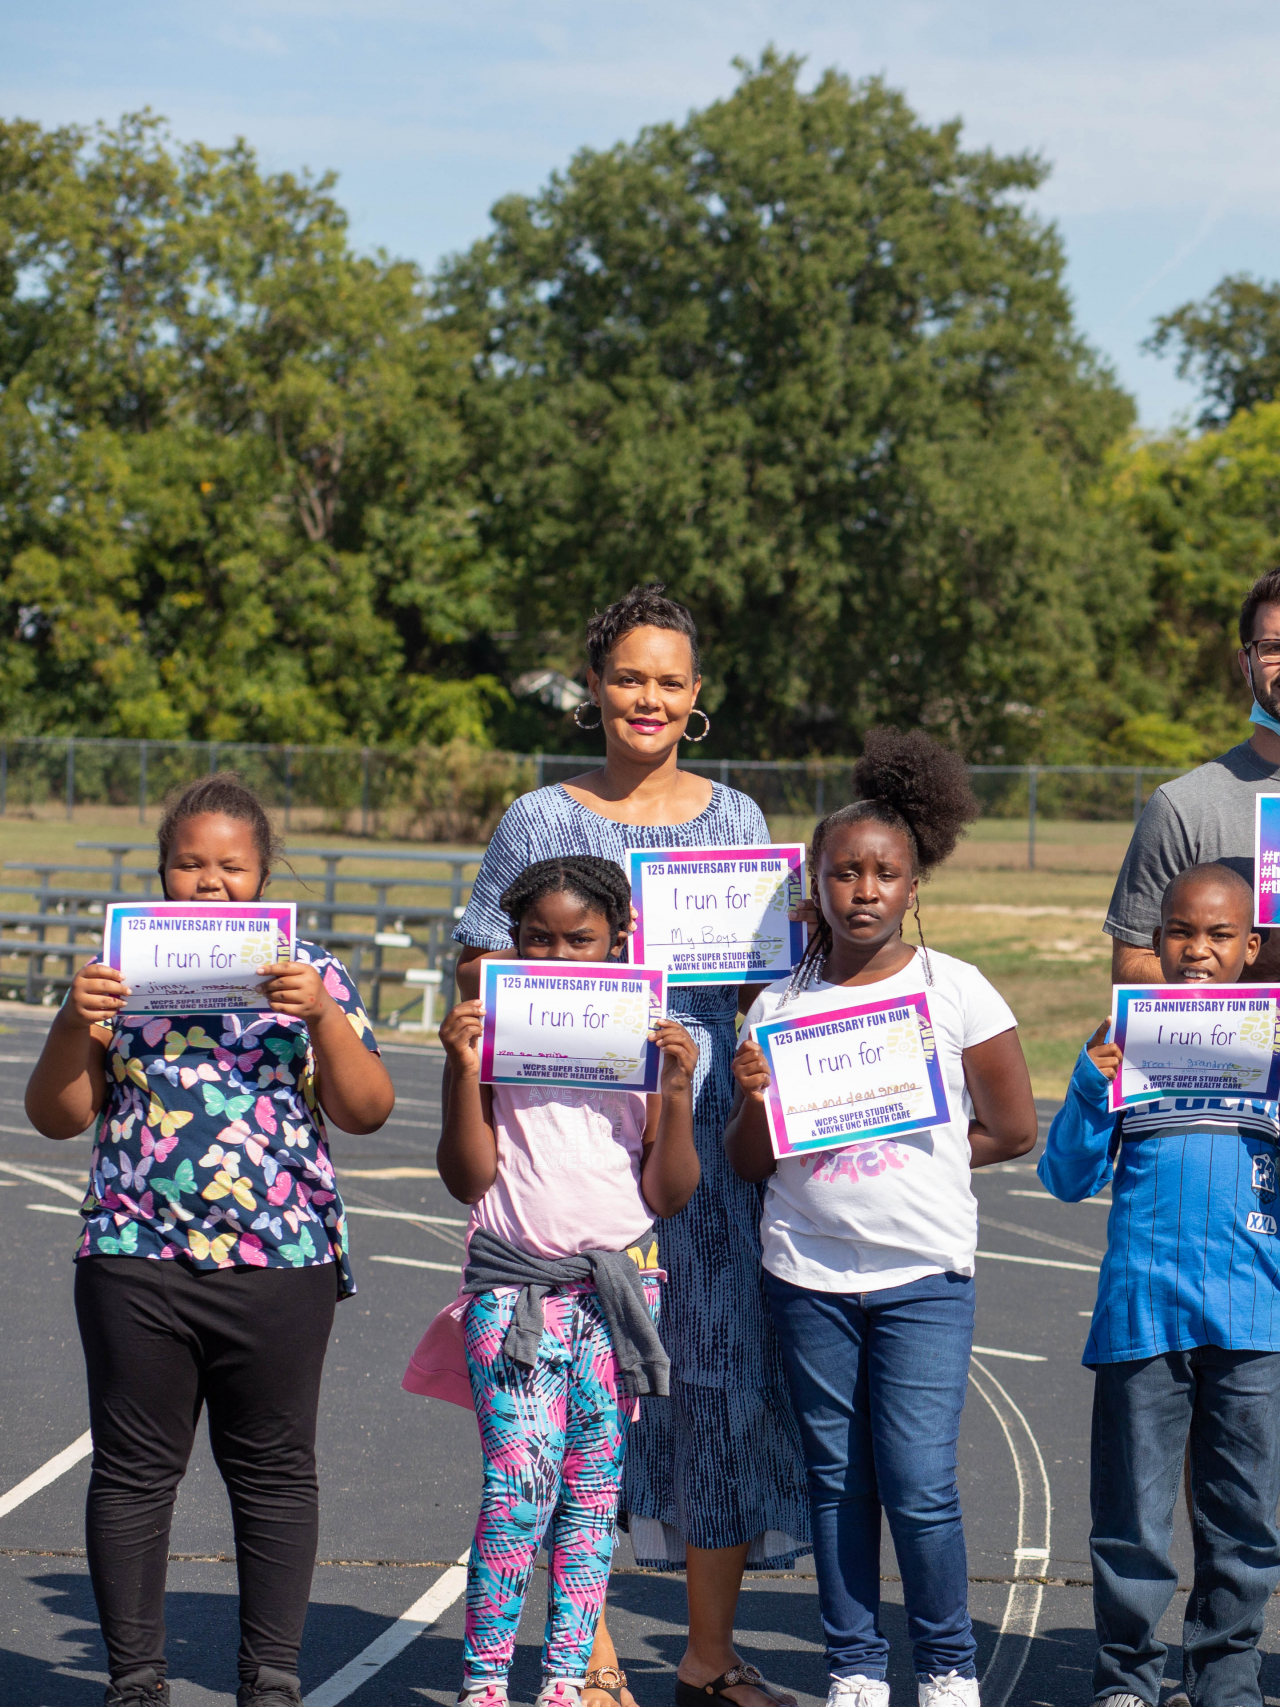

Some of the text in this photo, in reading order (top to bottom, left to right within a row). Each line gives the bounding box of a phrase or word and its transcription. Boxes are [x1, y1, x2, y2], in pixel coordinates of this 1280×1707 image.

[647, 861, 781, 875] 125 ANNIVERSARY FUN RUN
[674, 886, 751, 910] I run for
[128, 920, 270, 932] 125 ANNIVERSARY FUN RUN
[671, 926, 738, 949] My Boys
[154, 945, 236, 968] I run for
[673, 954, 695, 962] WCPS
[722, 951, 761, 960] STUDENTS
[675, 963, 700, 971] WAYNE
[719, 961, 745, 969] HEALTH
[748, 960, 766, 968] CARE
[503, 978, 642, 992] 125 ANNIVERSARY FUN RUN
[529, 1003, 609, 1028] I run for
[1134, 1001, 1269, 1012] 125 ANNIVERSARY FUN RUN
[774, 1009, 910, 1045] 125 ANNIVERSARY FUN RUN
[1158, 1024, 1237, 1045] I run for
[806, 1042, 884, 1075] I run for
[1142, 1059, 1173, 1068] great
[823, 1096, 842, 1107] and
[815, 1103, 903, 1127] WCPS SUPER STUDENTS
[818, 1110, 911, 1135] WAYNE UNC HEALTH CARE
[1255, 1157, 1275, 1191] 23
[1249, 1215, 1275, 1232] XXL
